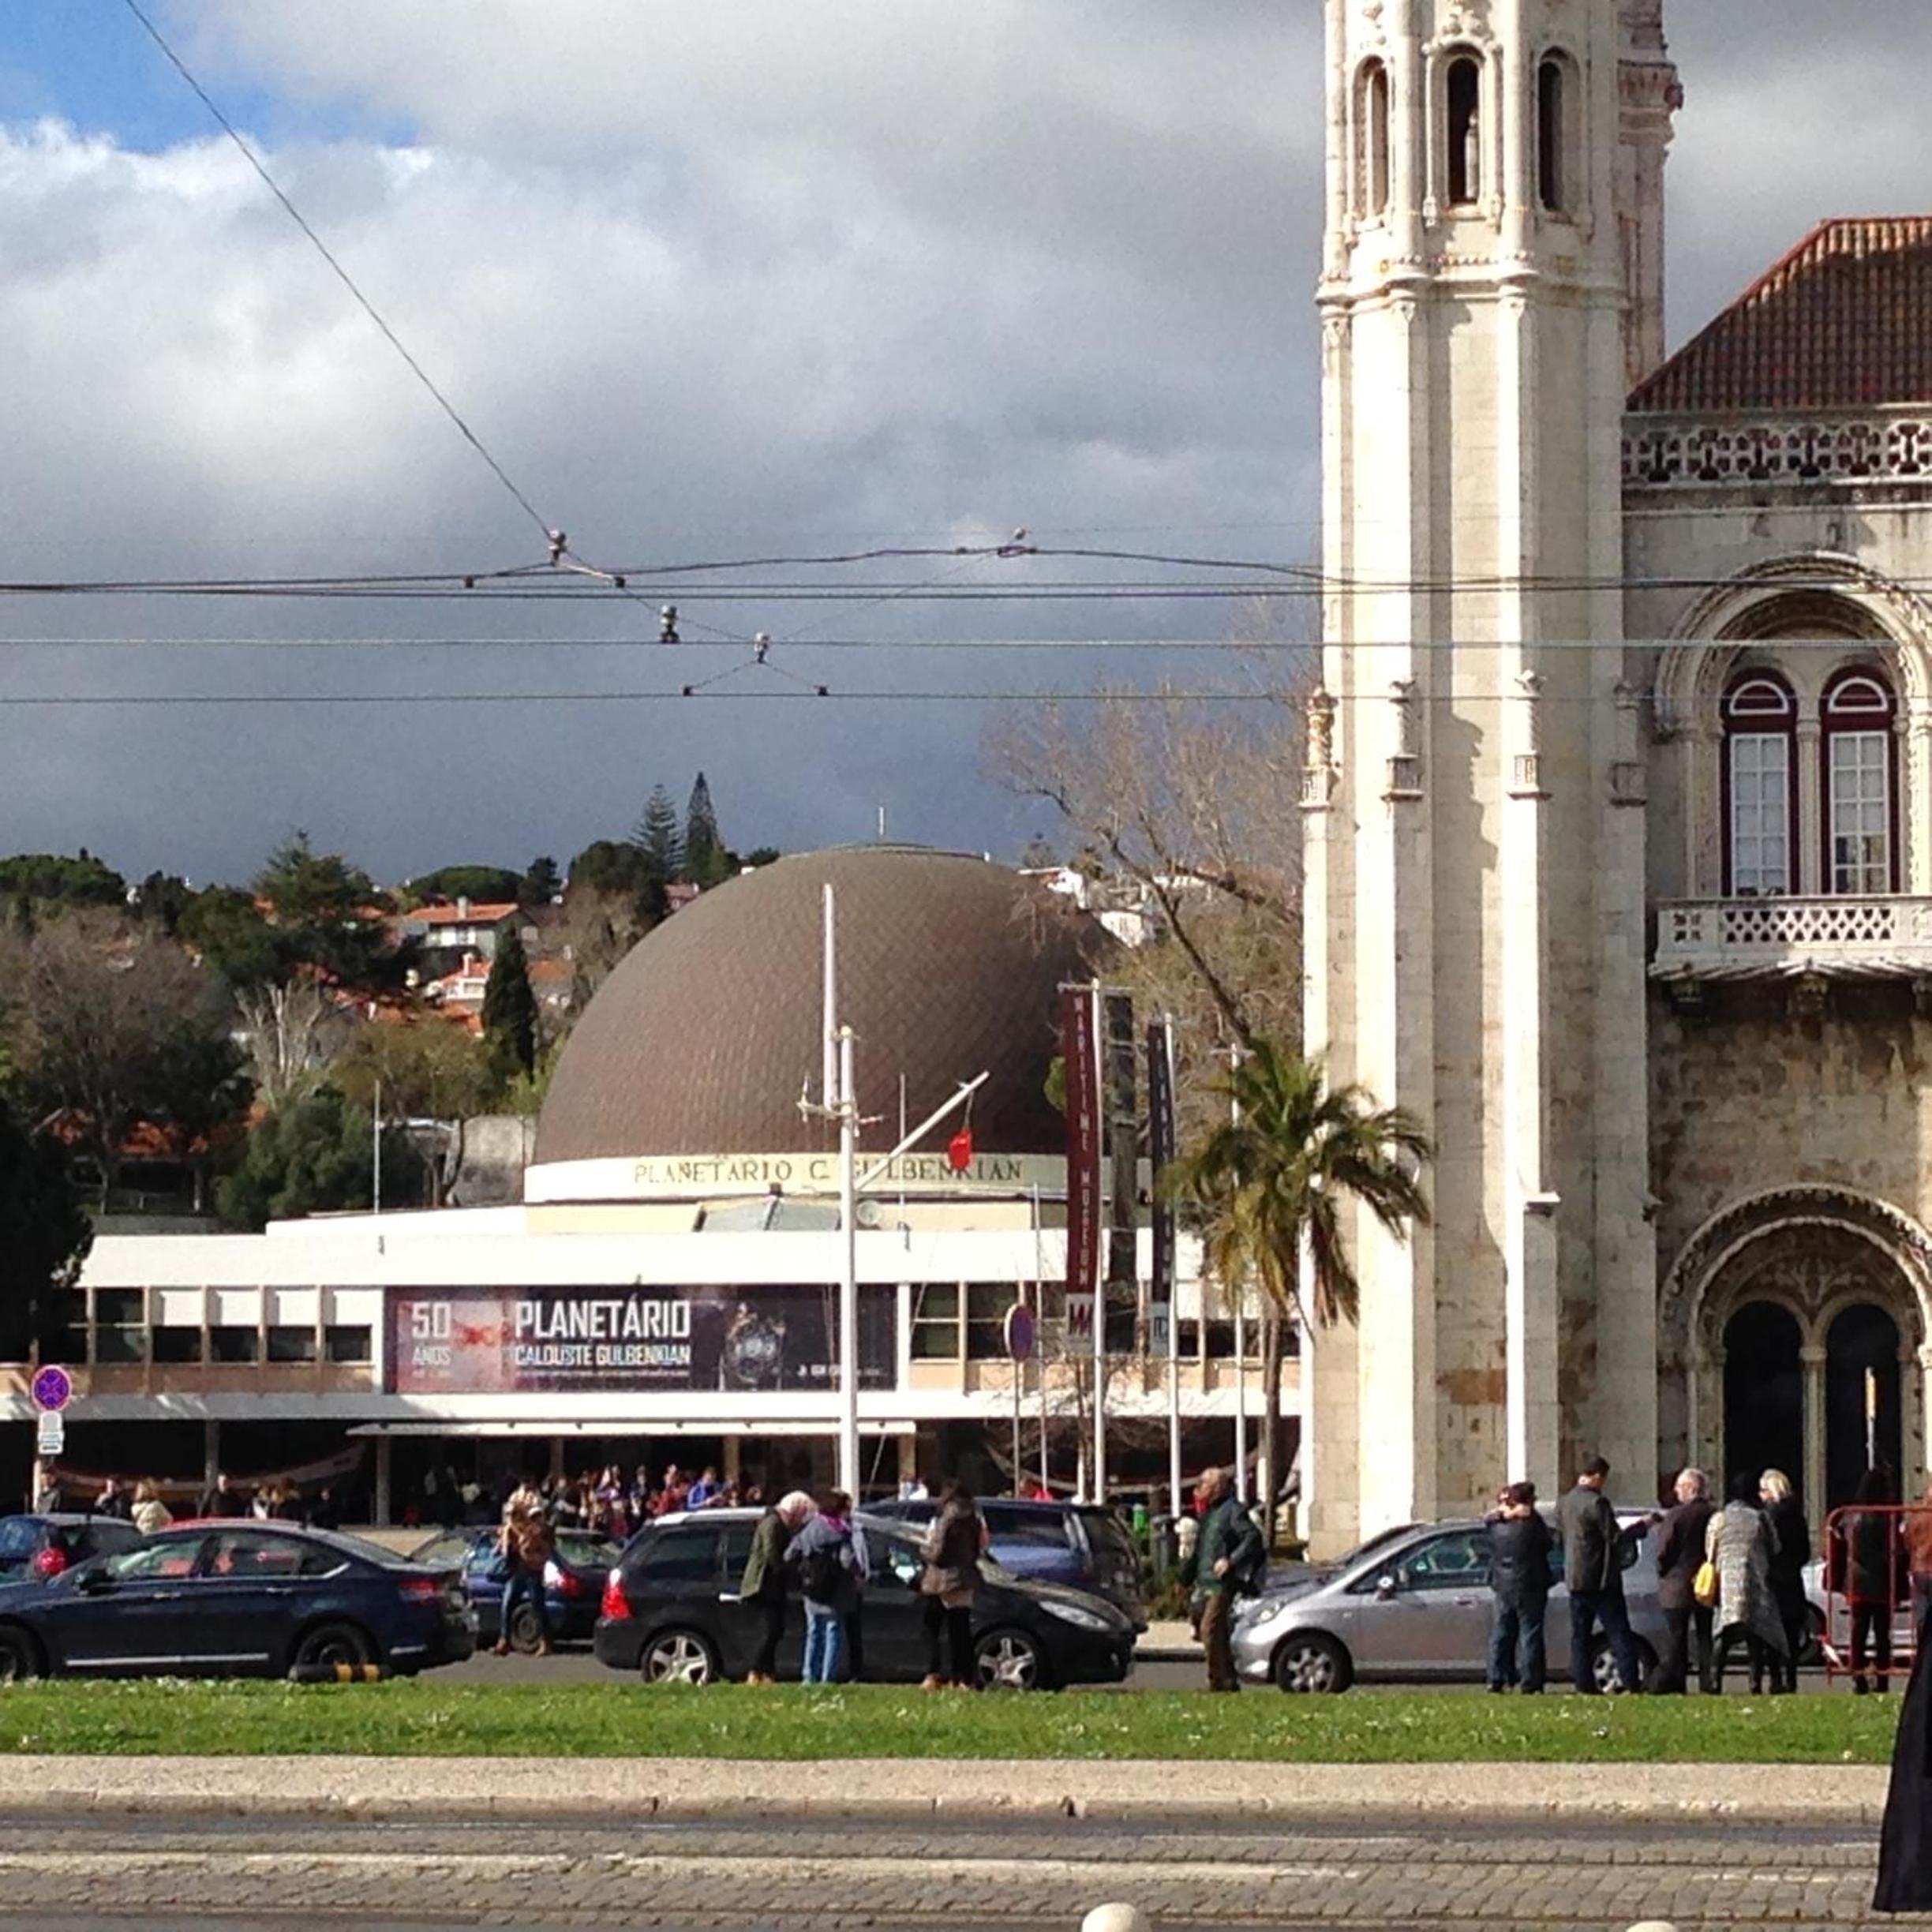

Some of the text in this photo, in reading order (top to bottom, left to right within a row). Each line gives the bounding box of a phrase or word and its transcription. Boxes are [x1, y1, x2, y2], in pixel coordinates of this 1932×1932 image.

[1073, 996, 1090, 1152] MARITIME
[411, 1301, 451, 1339] 50
[515, 1294, 691, 1339] PLANETÁRIO
[412, 1345, 451, 1366] ANOS
[515, 1345, 691, 1367] CALOUSTE GULBENKIAN
